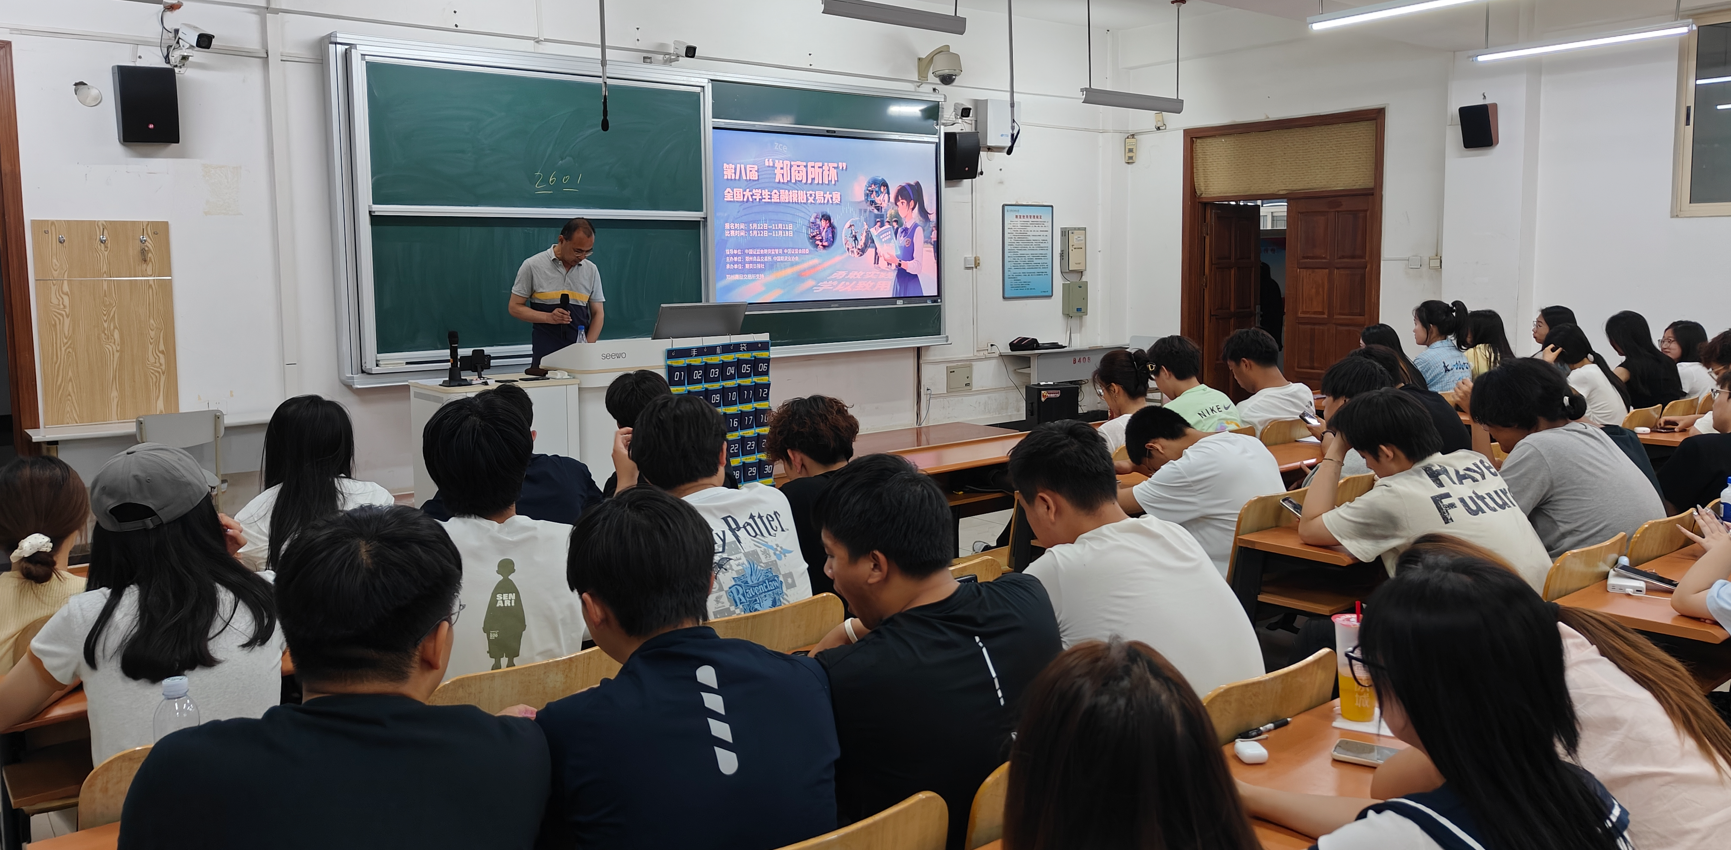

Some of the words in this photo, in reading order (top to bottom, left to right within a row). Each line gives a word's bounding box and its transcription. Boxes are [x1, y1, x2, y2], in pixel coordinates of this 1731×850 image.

[723, 163, 758, 180] 第八届
[534, 171, 582, 189] 2601
[724, 188, 841, 204] 全国大学生金融模拟交易大赛
[812, 281, 892, 293] 学以致用
[601, 352, 627, 360] seewo
[726, 366, 735, 375] 04
[741, 364, 751, 373] 05
[758, 363, 768, 372] 06
[674, 371, 684, 381] 01
[693, 370, 703, 379] 02
[709, 368, 719, 377] 03
[728, 391, 737, 401] 10
[744, 390, 752, 399] 11
[759, 388, 768, 397] 12
[711, 394, 720, 403] 09
[1197, 404, 1223, 419] NIKE
[729, 418, 738, 427] 16
[744, 416, 753, 425] 17
[730, 444, 739, 453] 22
[746, 441, 756, 450] 23
[747, 467, 757, 476] 29
[763, 464, 773, 474] 30
[721, 511, 786, 553] Potter
[728, 578, 781, 608] Ravenclaw
